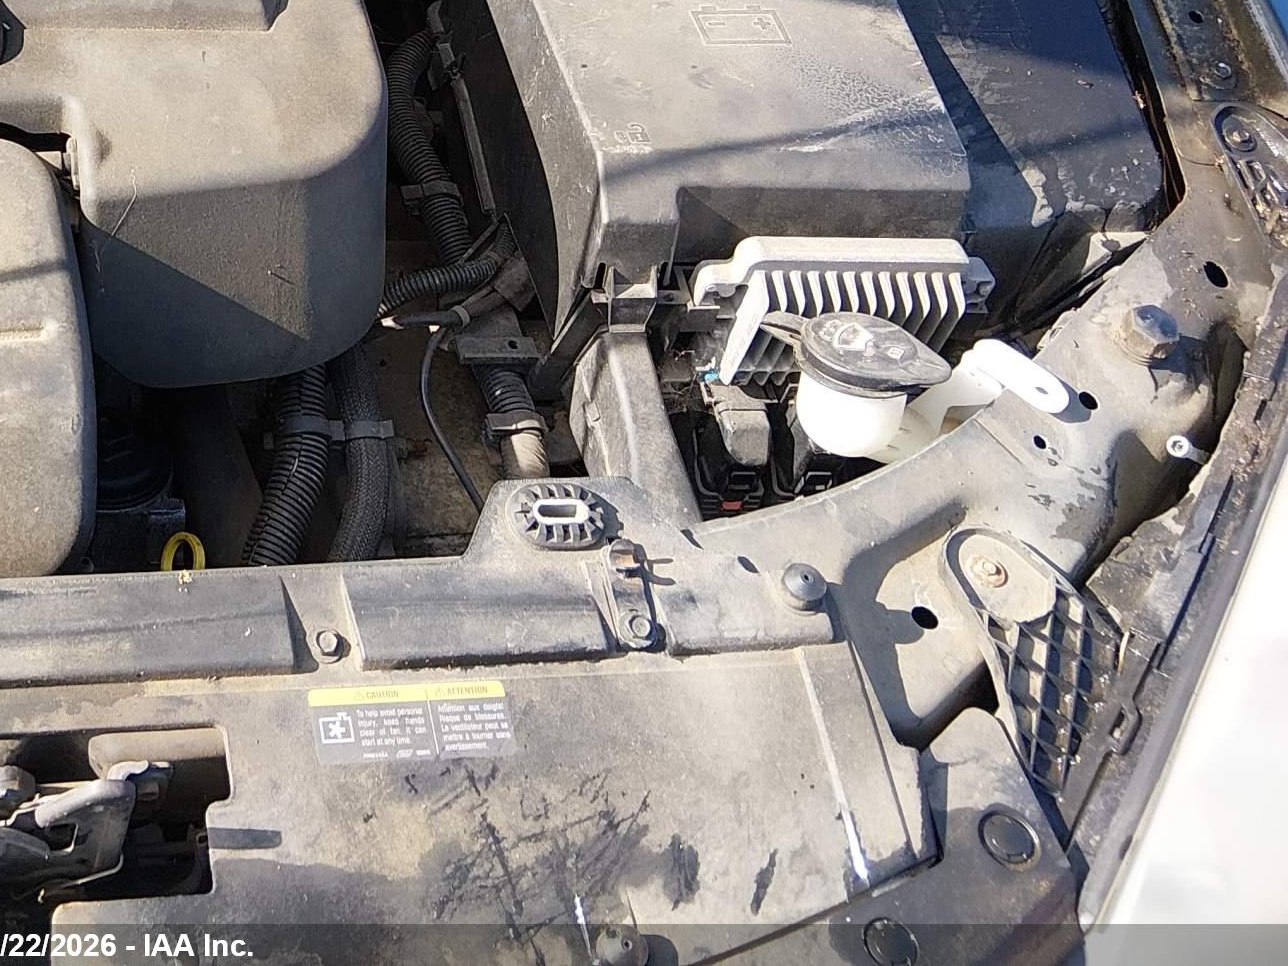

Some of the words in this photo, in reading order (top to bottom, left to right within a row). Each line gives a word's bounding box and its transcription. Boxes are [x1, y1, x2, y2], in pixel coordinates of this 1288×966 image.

[365, 691, 399, 699] CAUTION
[447, 686, 488, 696] ATTENTION
[365, 709, 379, 718] help
[380, 708, 396, 717] avoid
[405, 716, 425, 725] hands
[361, 737, 376, 746] start
[384, 737, 395, 747] any
